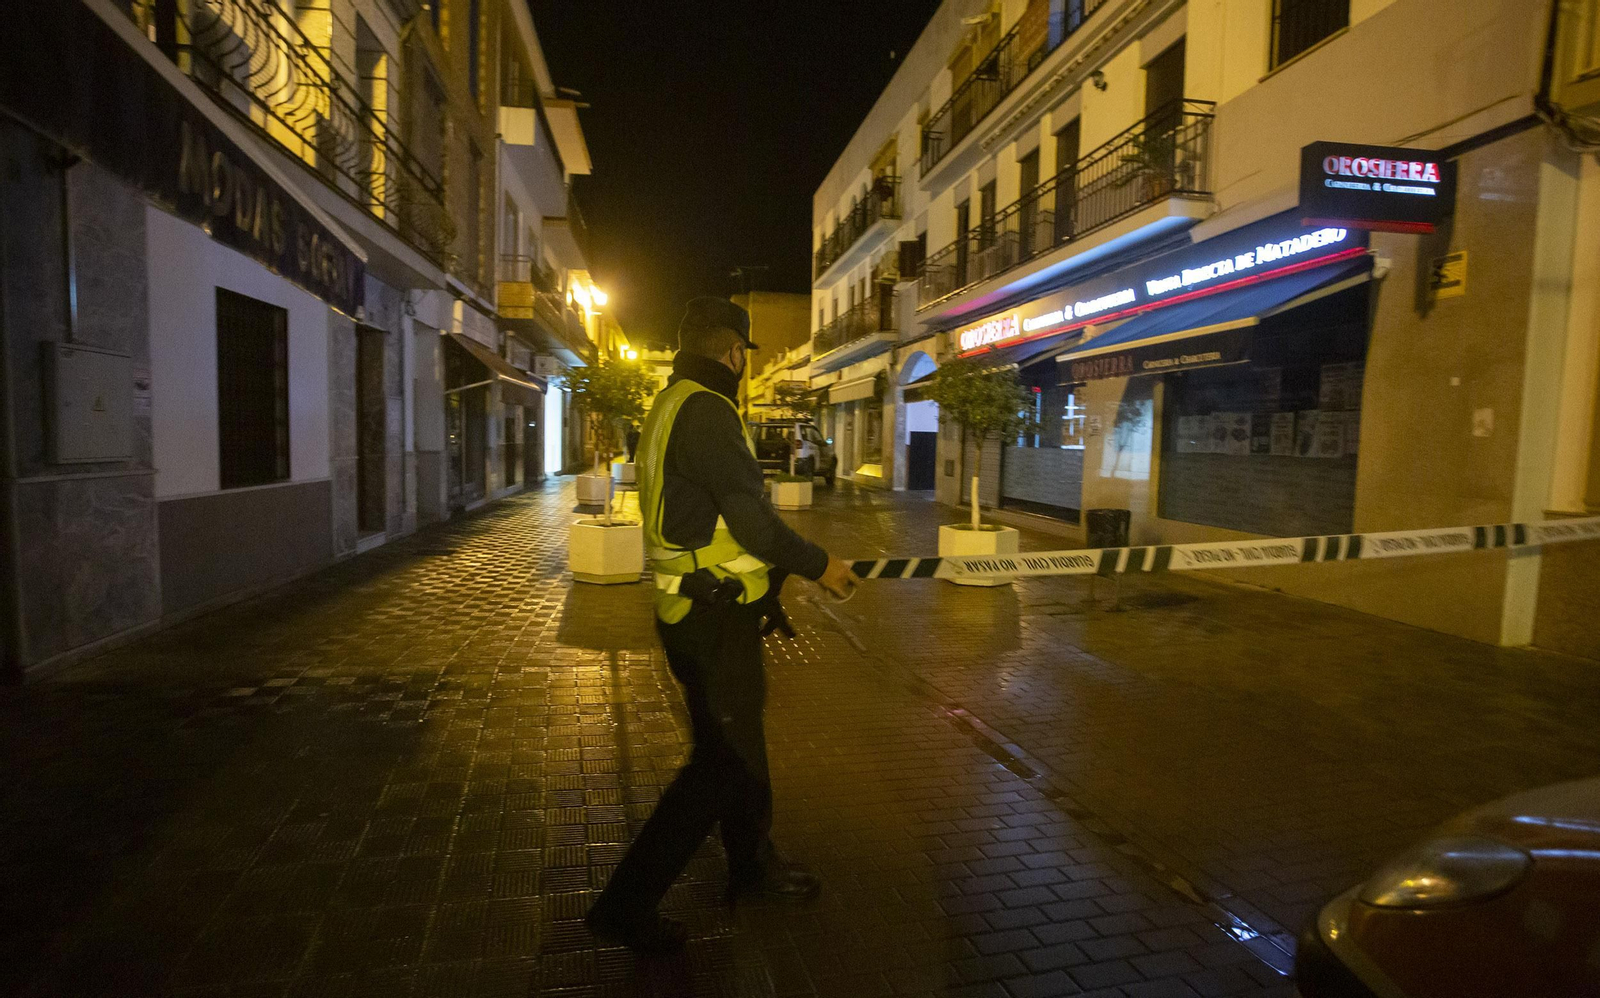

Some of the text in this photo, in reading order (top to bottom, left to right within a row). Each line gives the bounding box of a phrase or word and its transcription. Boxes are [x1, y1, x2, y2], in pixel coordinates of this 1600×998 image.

[1322, 155, 1441, 182] OROSIERRA
[963, 554, 1094, 573] GUARDIA CIVIL NO PASAR
